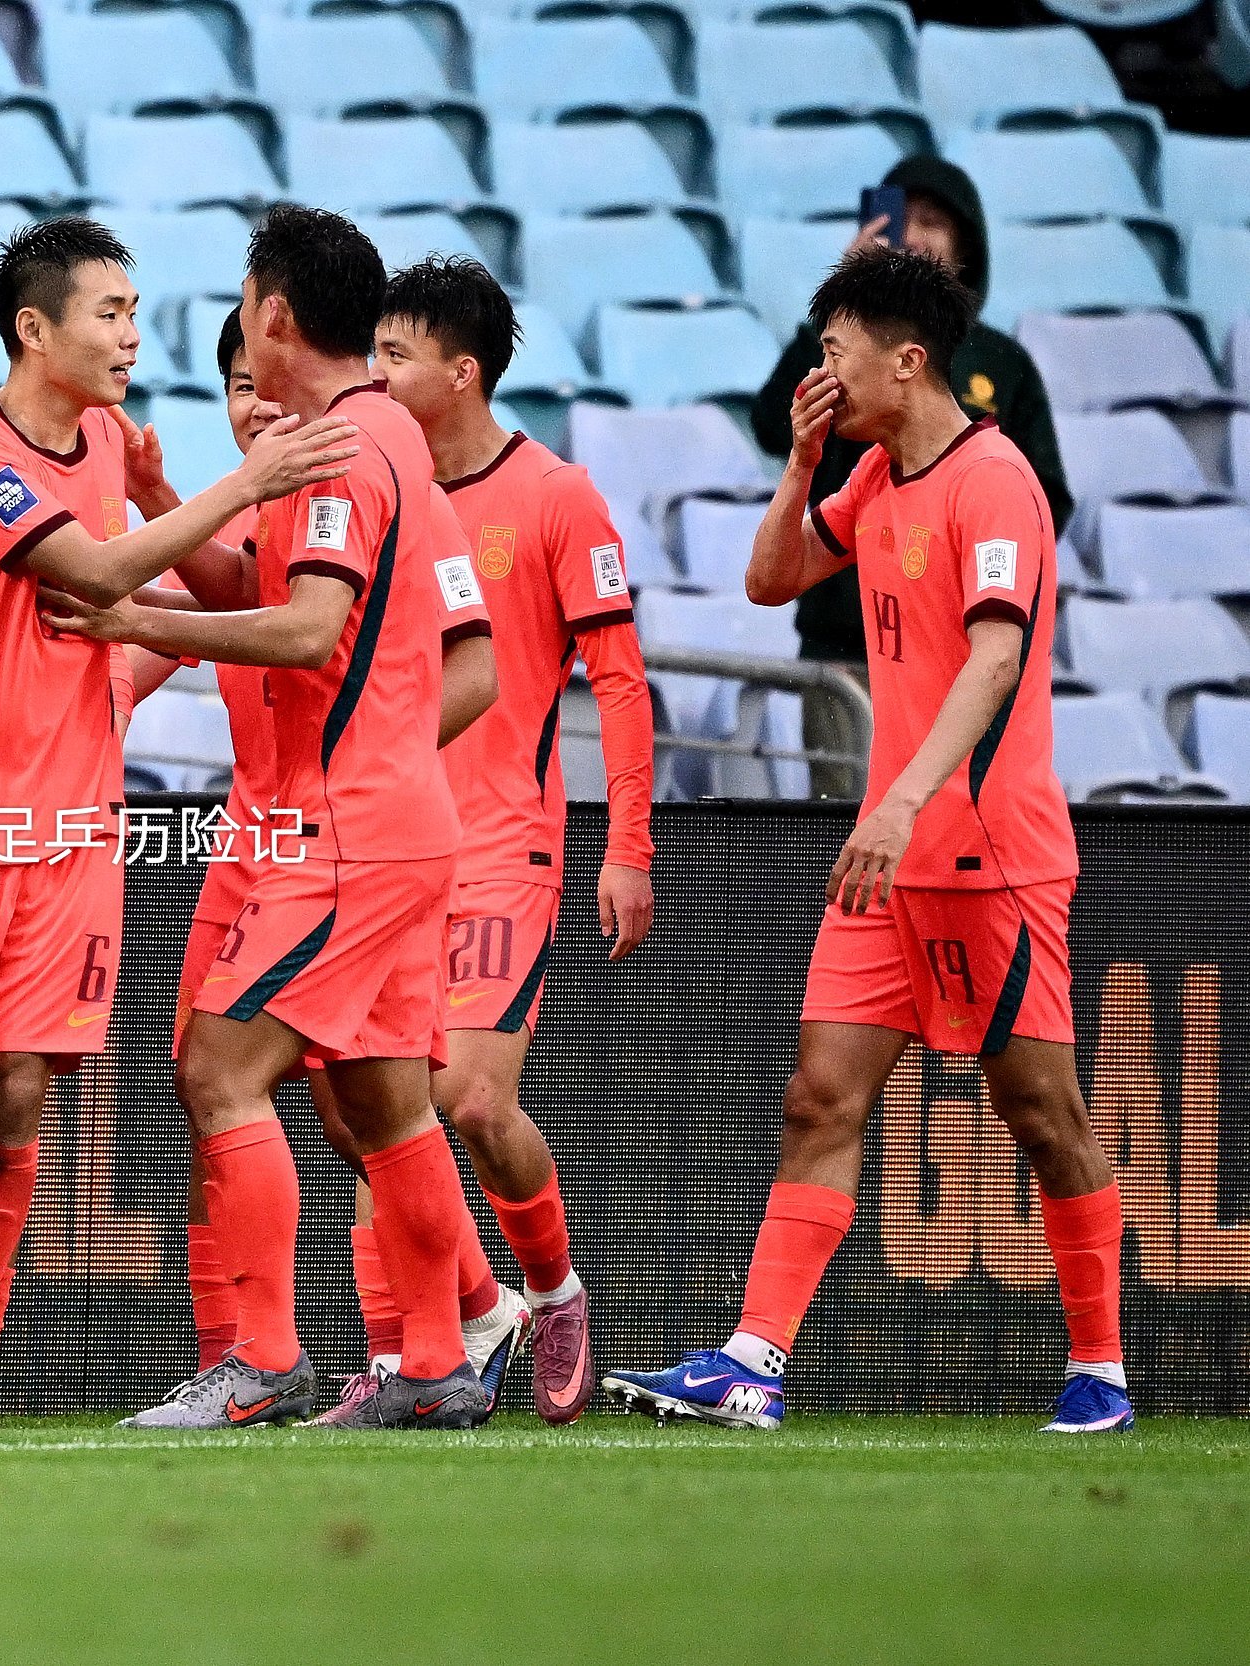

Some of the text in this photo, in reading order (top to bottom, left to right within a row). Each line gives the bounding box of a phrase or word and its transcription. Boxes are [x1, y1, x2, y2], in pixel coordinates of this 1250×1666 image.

[3, 491, 25, 512] 2026
[483, 529, 513, 540] CFA
[910, 528, 929, 540] CFA
[870, 588, 905, 663] 19
[77, 933, 110, 1003] 6
[449, 916, 513, 984] 20
[922, 939, 980, 1005] 19
